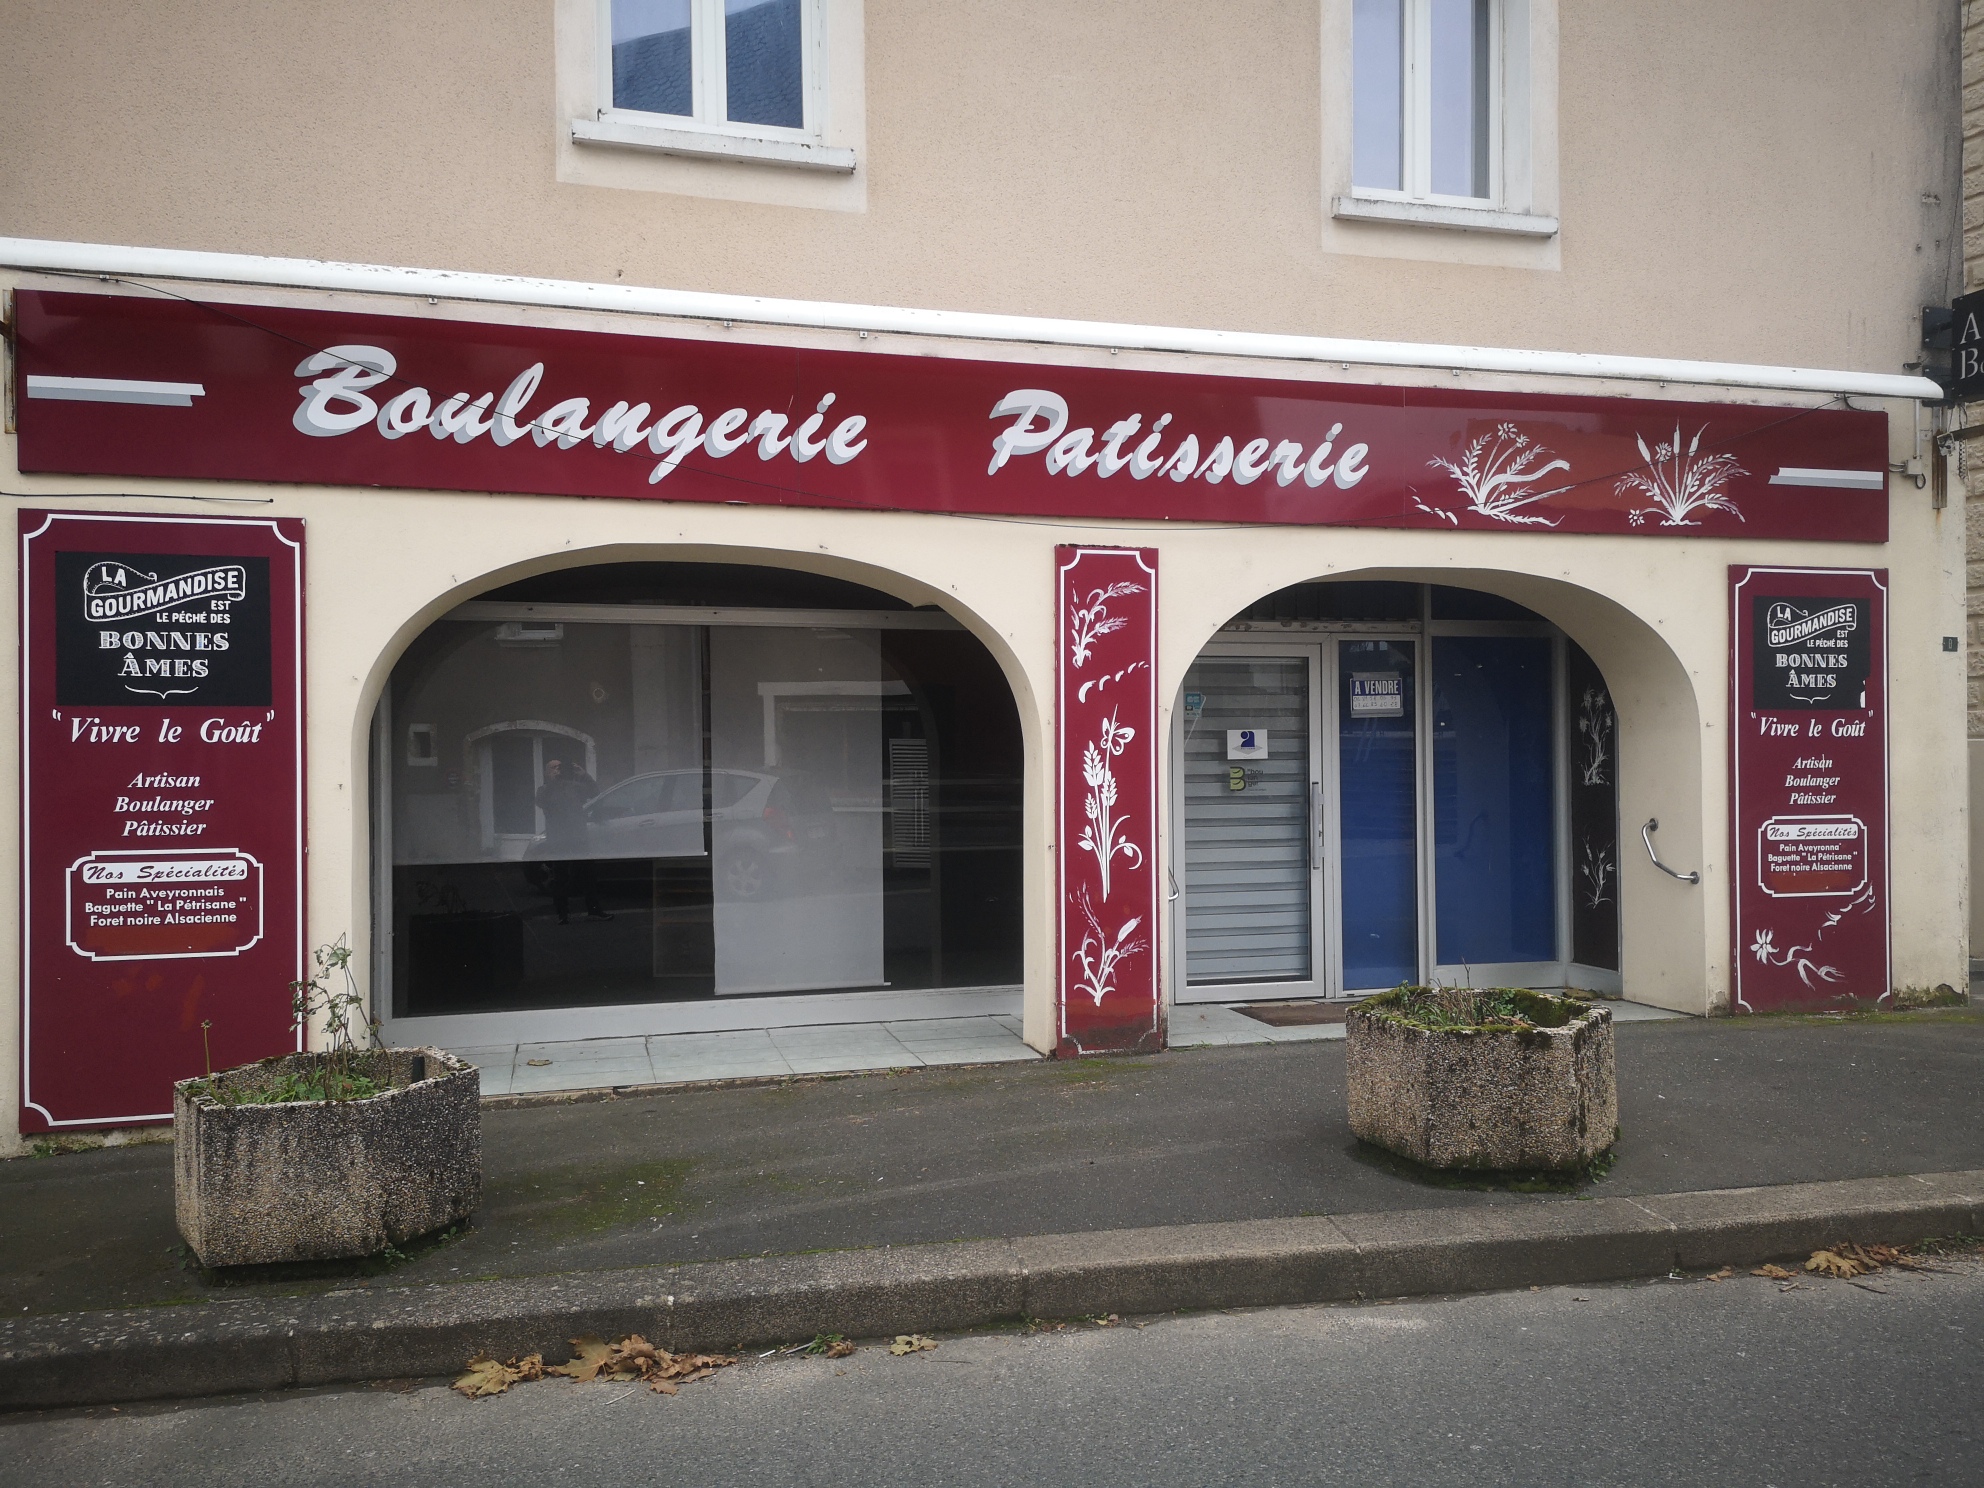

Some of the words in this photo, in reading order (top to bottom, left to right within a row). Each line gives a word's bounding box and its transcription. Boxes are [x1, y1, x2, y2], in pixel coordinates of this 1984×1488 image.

[293, 344, 868, 485] Boulangerie
[987, 388, 1370, 489] Patisserie
[101, 567, 126, 586] LA
[91, 570, 240, 617] GOURMANDISE
[211, 601, 231, 610] EST
[157, 613, 169, 622] LE
[172, 611, 207, 623] PÉCHÉ
[210, 613, 231, 624] DES
[1777, 606, 1791, 621] LA
[1771, 608, 1853, 643] GOURMANDISE
[99, 631, 229, 650] BONNES
[1837, 630, 1848, 638] EST
[1816, 638, 1835, 648] PÉCHÉ
[1837, 640, 1848, 648] DES
[118, 652, 209, 677] ÂMES
[1776, 654, 1848, 668] BONNES
[1786, 669, 1837, 688] ÂMES
[1355, 681, 1361, 694] A
[1365, 681, 1398, 694] VENDRE
[159, 718, 182, 742] le
[1809, 719, 1822, 736] le
[1792, 756, 1833, 769] Artisan
[128, 772, 201, 788] Artisan
[1785, 775, 1840, 789] Boulanger
[114, 796, 214, 815] Boulanger
[1789, 793, 1836, 805] Pâtissier
[121, 820, 206, 837] Pâtissier
[1769, 827, 1790, 837] Nos
[1797, 826, 1857, 839] Spécialités
[1780, 844, 1796, 852] Pain
[86, 866, 124, 880] Nos
[137, 863, 246, 881] Spécialités
[1771, 864, 1790, 872] Foret
[1791, 864, 1810, 872] noire
[1812, 863, 1852, 871] Alsacienne
[107, 889, 136, 899] Pain
[140, 886, 225, 899] Aveyronnais
[85, 902, 143, 915] Baguette
[90, 915, 124, 927] Foret
[127, 915, 161, 925] noire
[164, 913, 237, 924] Alsacienne
